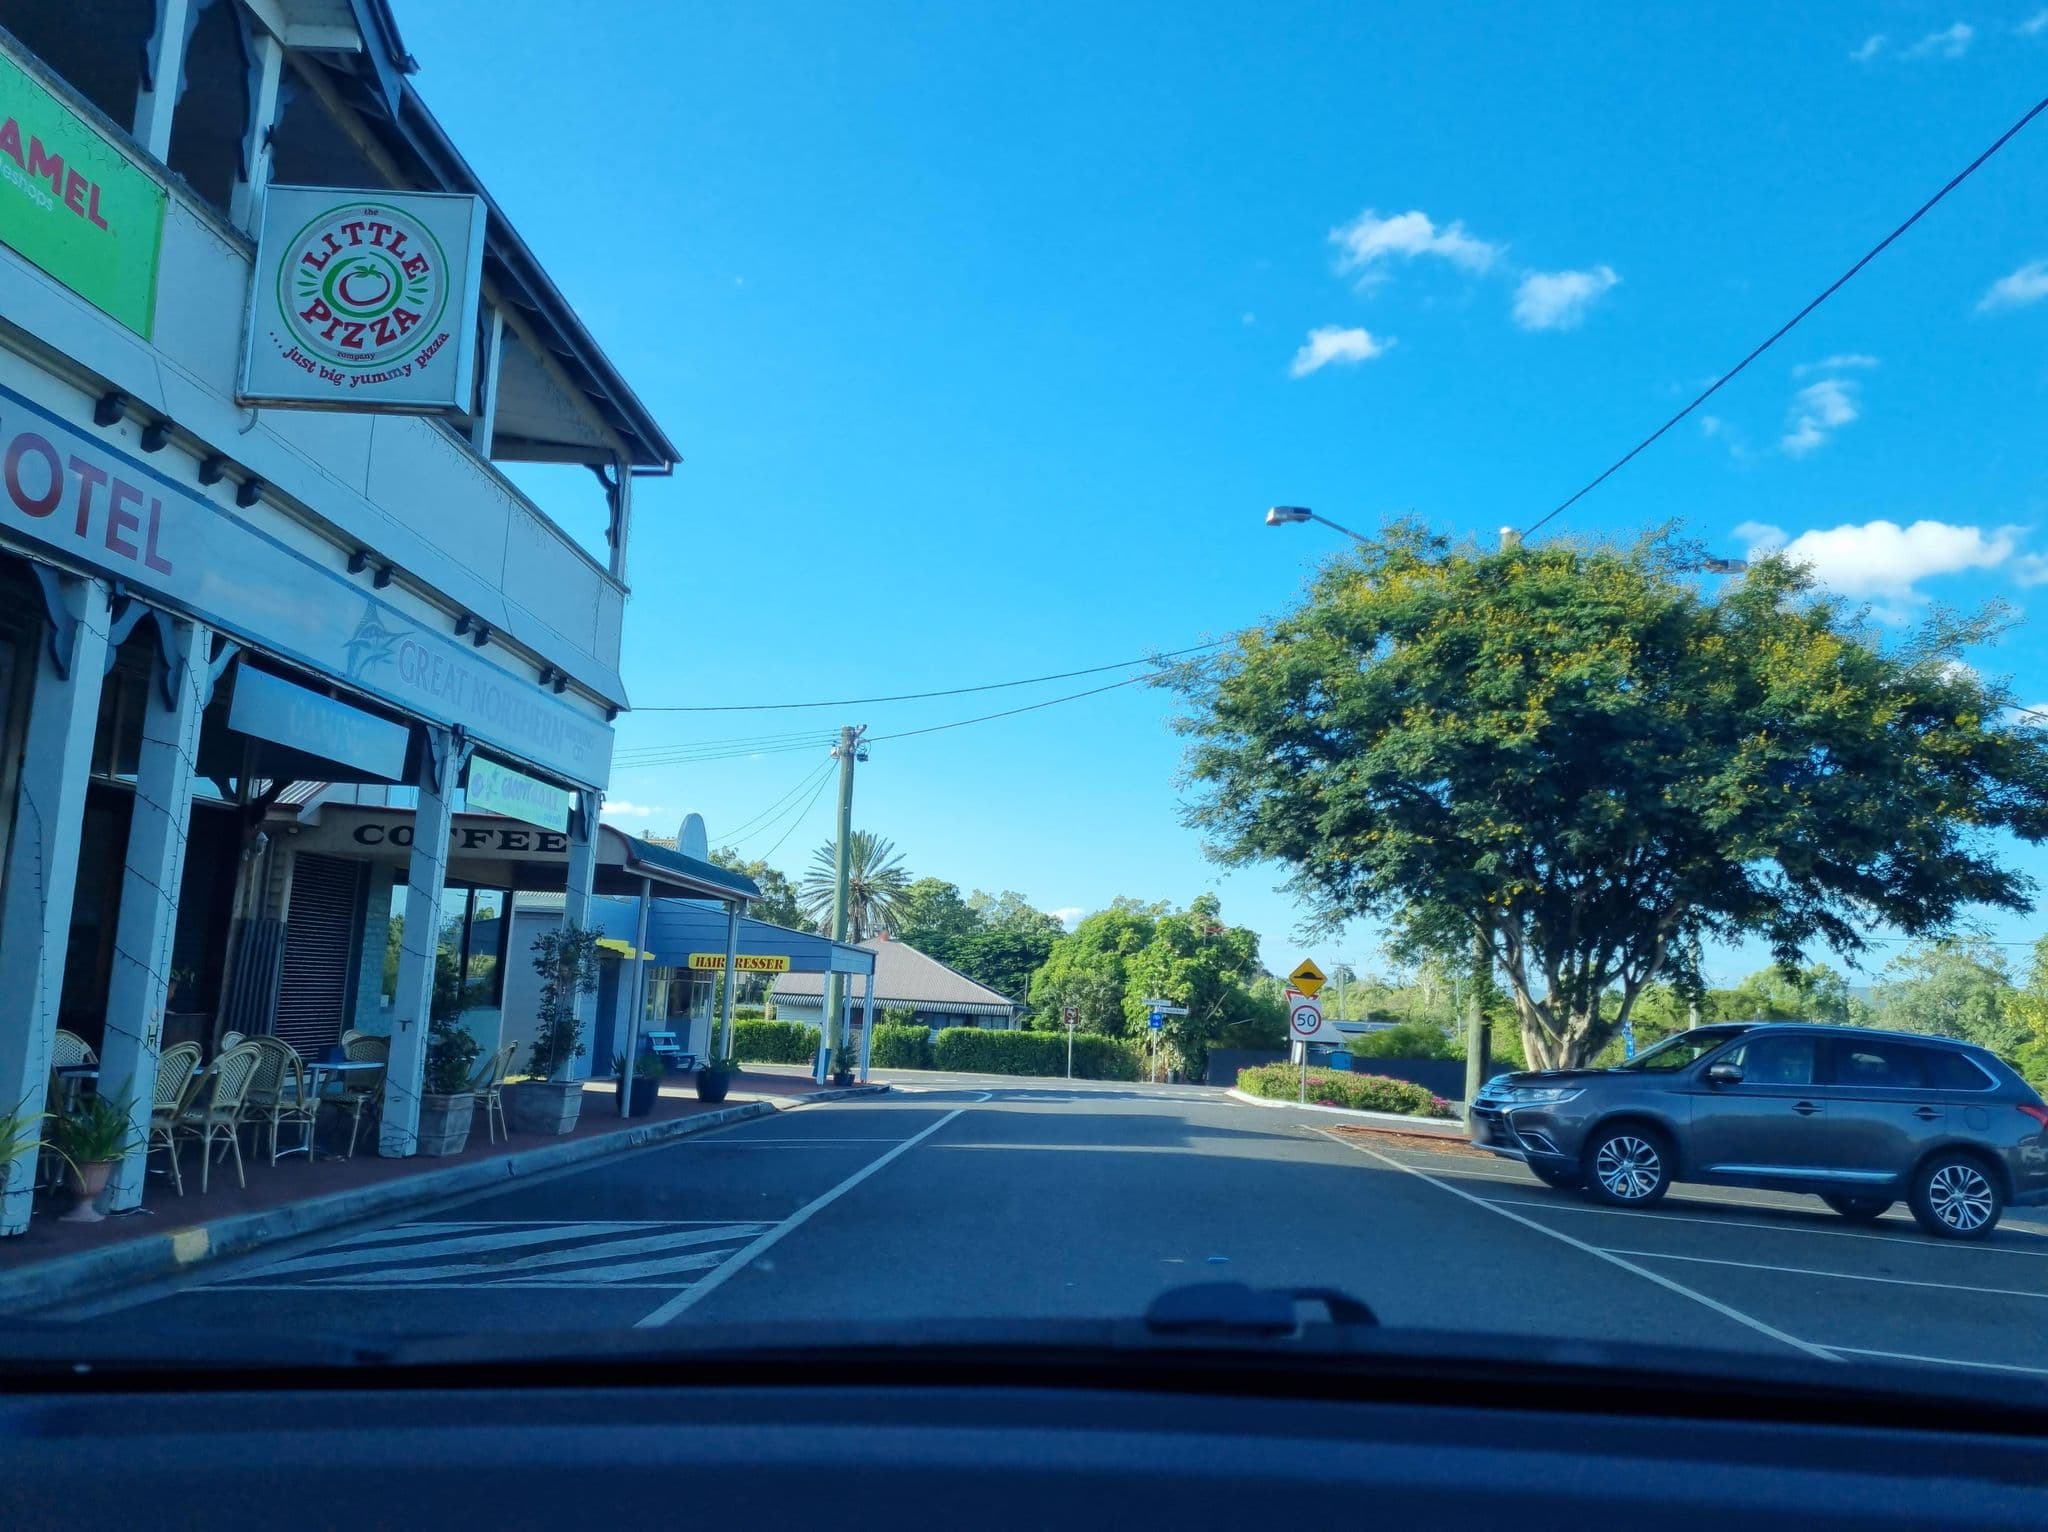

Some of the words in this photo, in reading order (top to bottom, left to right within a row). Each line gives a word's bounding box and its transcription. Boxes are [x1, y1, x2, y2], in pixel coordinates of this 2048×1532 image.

[0, 116, 108, 232] AMEL
[0, 158, 54, 212] eshops
[364, 208, 379, 216] the
[301, 221, 430, 281] LITTLE
[299, 297, 422, 350] PIZZA
[319, 365, 346, 387] big
[349, 363, 413, 388] yummy
[414, 331, 450, 369] pizza
[336, 351, 376, 361] company
[0, 417, 173, 577] OTEL
[399, 639, 469, 706] GREAT
[471, 675, 562, 753] NORTHERN
[353, 824, 568, 853] COFEE
[695, 956, 784, 970] HAIRRESSER
[1297, 1013, 1317, 1027] 50
